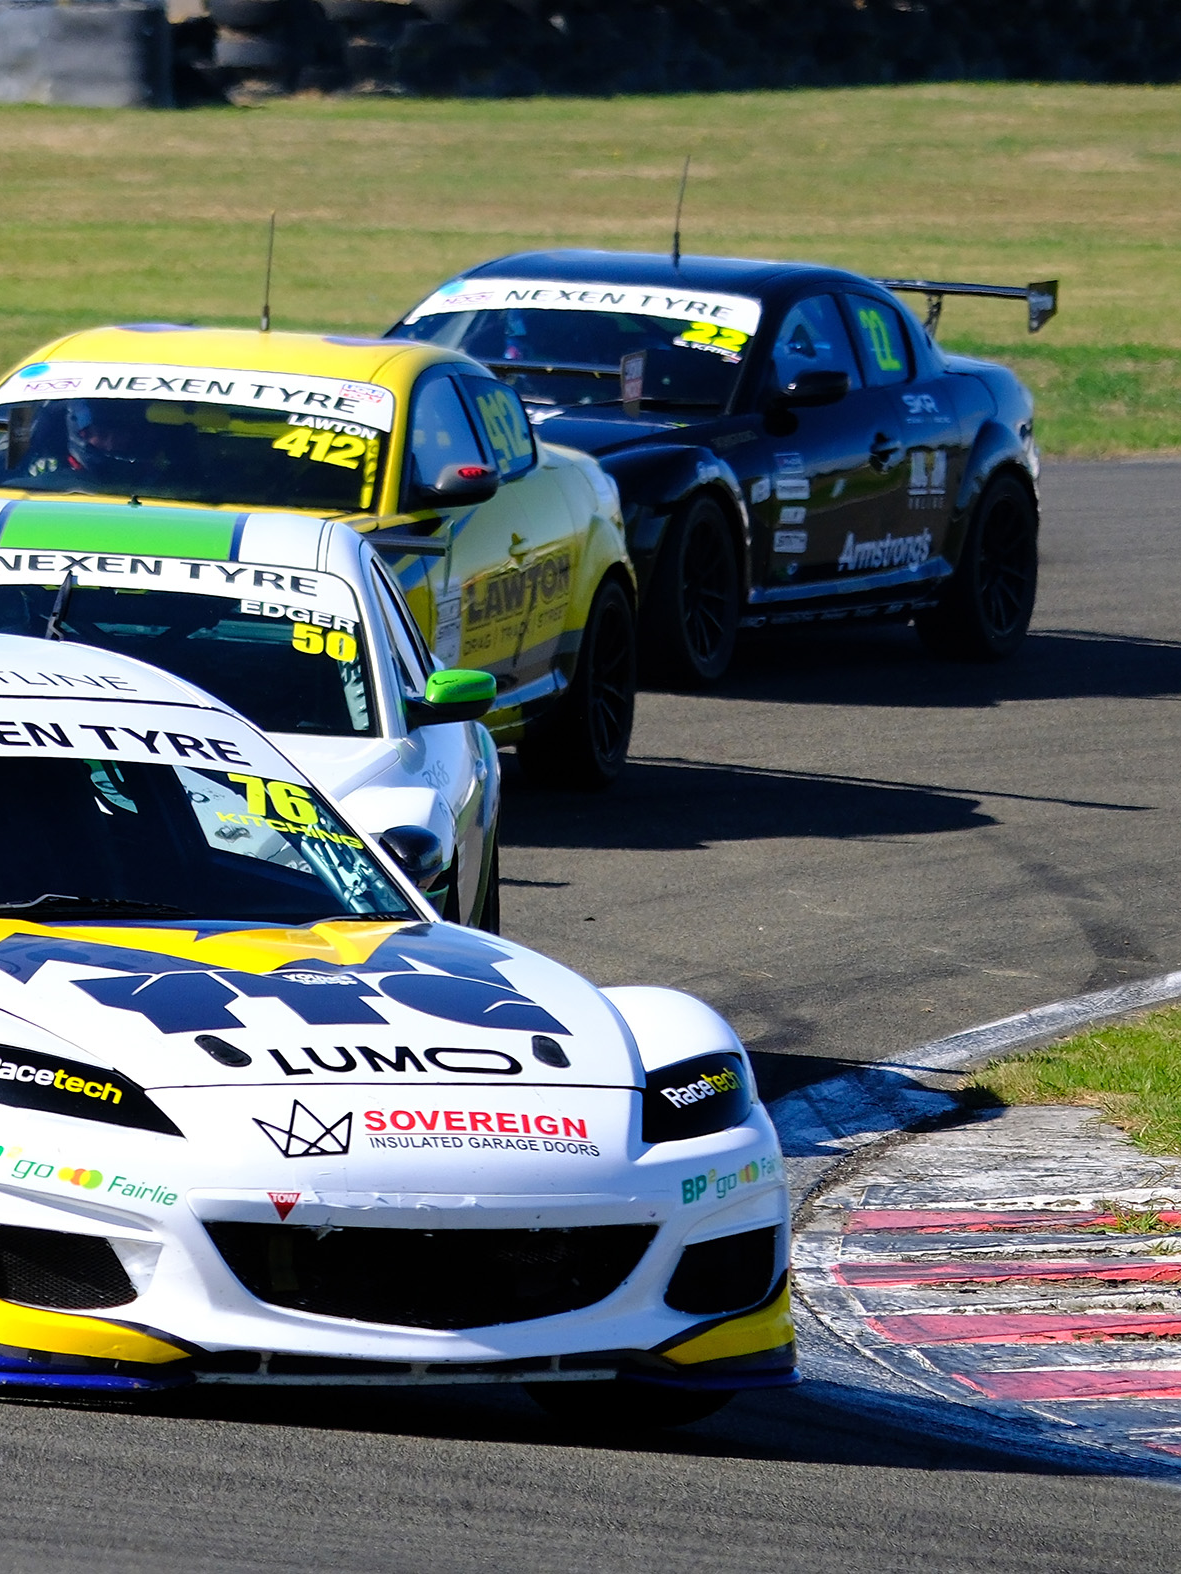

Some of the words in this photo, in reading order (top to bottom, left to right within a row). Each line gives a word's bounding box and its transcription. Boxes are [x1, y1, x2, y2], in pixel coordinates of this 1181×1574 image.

[506, 289, 626, 305] NEXEN
[640, 293, 733, 319] TYRE
[681, 321, 748, 353] 22
[96, 377, 235, 397] NEXEN
[250, 383, 360, 414] TYRE
[287, 413, 378, 440] LAWTON
[272, 428, 366, 470] 412
[180, 562, 318, 598] TYRE
[241, 598, 357, 634] EDGER
[292, 622, 357, 662] 50
[78, 723, 253, 767] TYRE
[227, 772, 319, 825] 76
[214, 811, 365, 850] KITCHING
[267, 1046, 523, 1077] LUMO
[660, 1066, 744, 1108] Racetech
[364, 1110, 588, 1139] SOVEREIGN
[369, 1136, 463, 1151] INSULATED
[469, 1137, 540, 1153] GARAGE
[542, 1140, 600, 1157] DOORS
[107, 1175, 179, 1206] Fairlie
[270, 1193, 298, 1204] TOW
